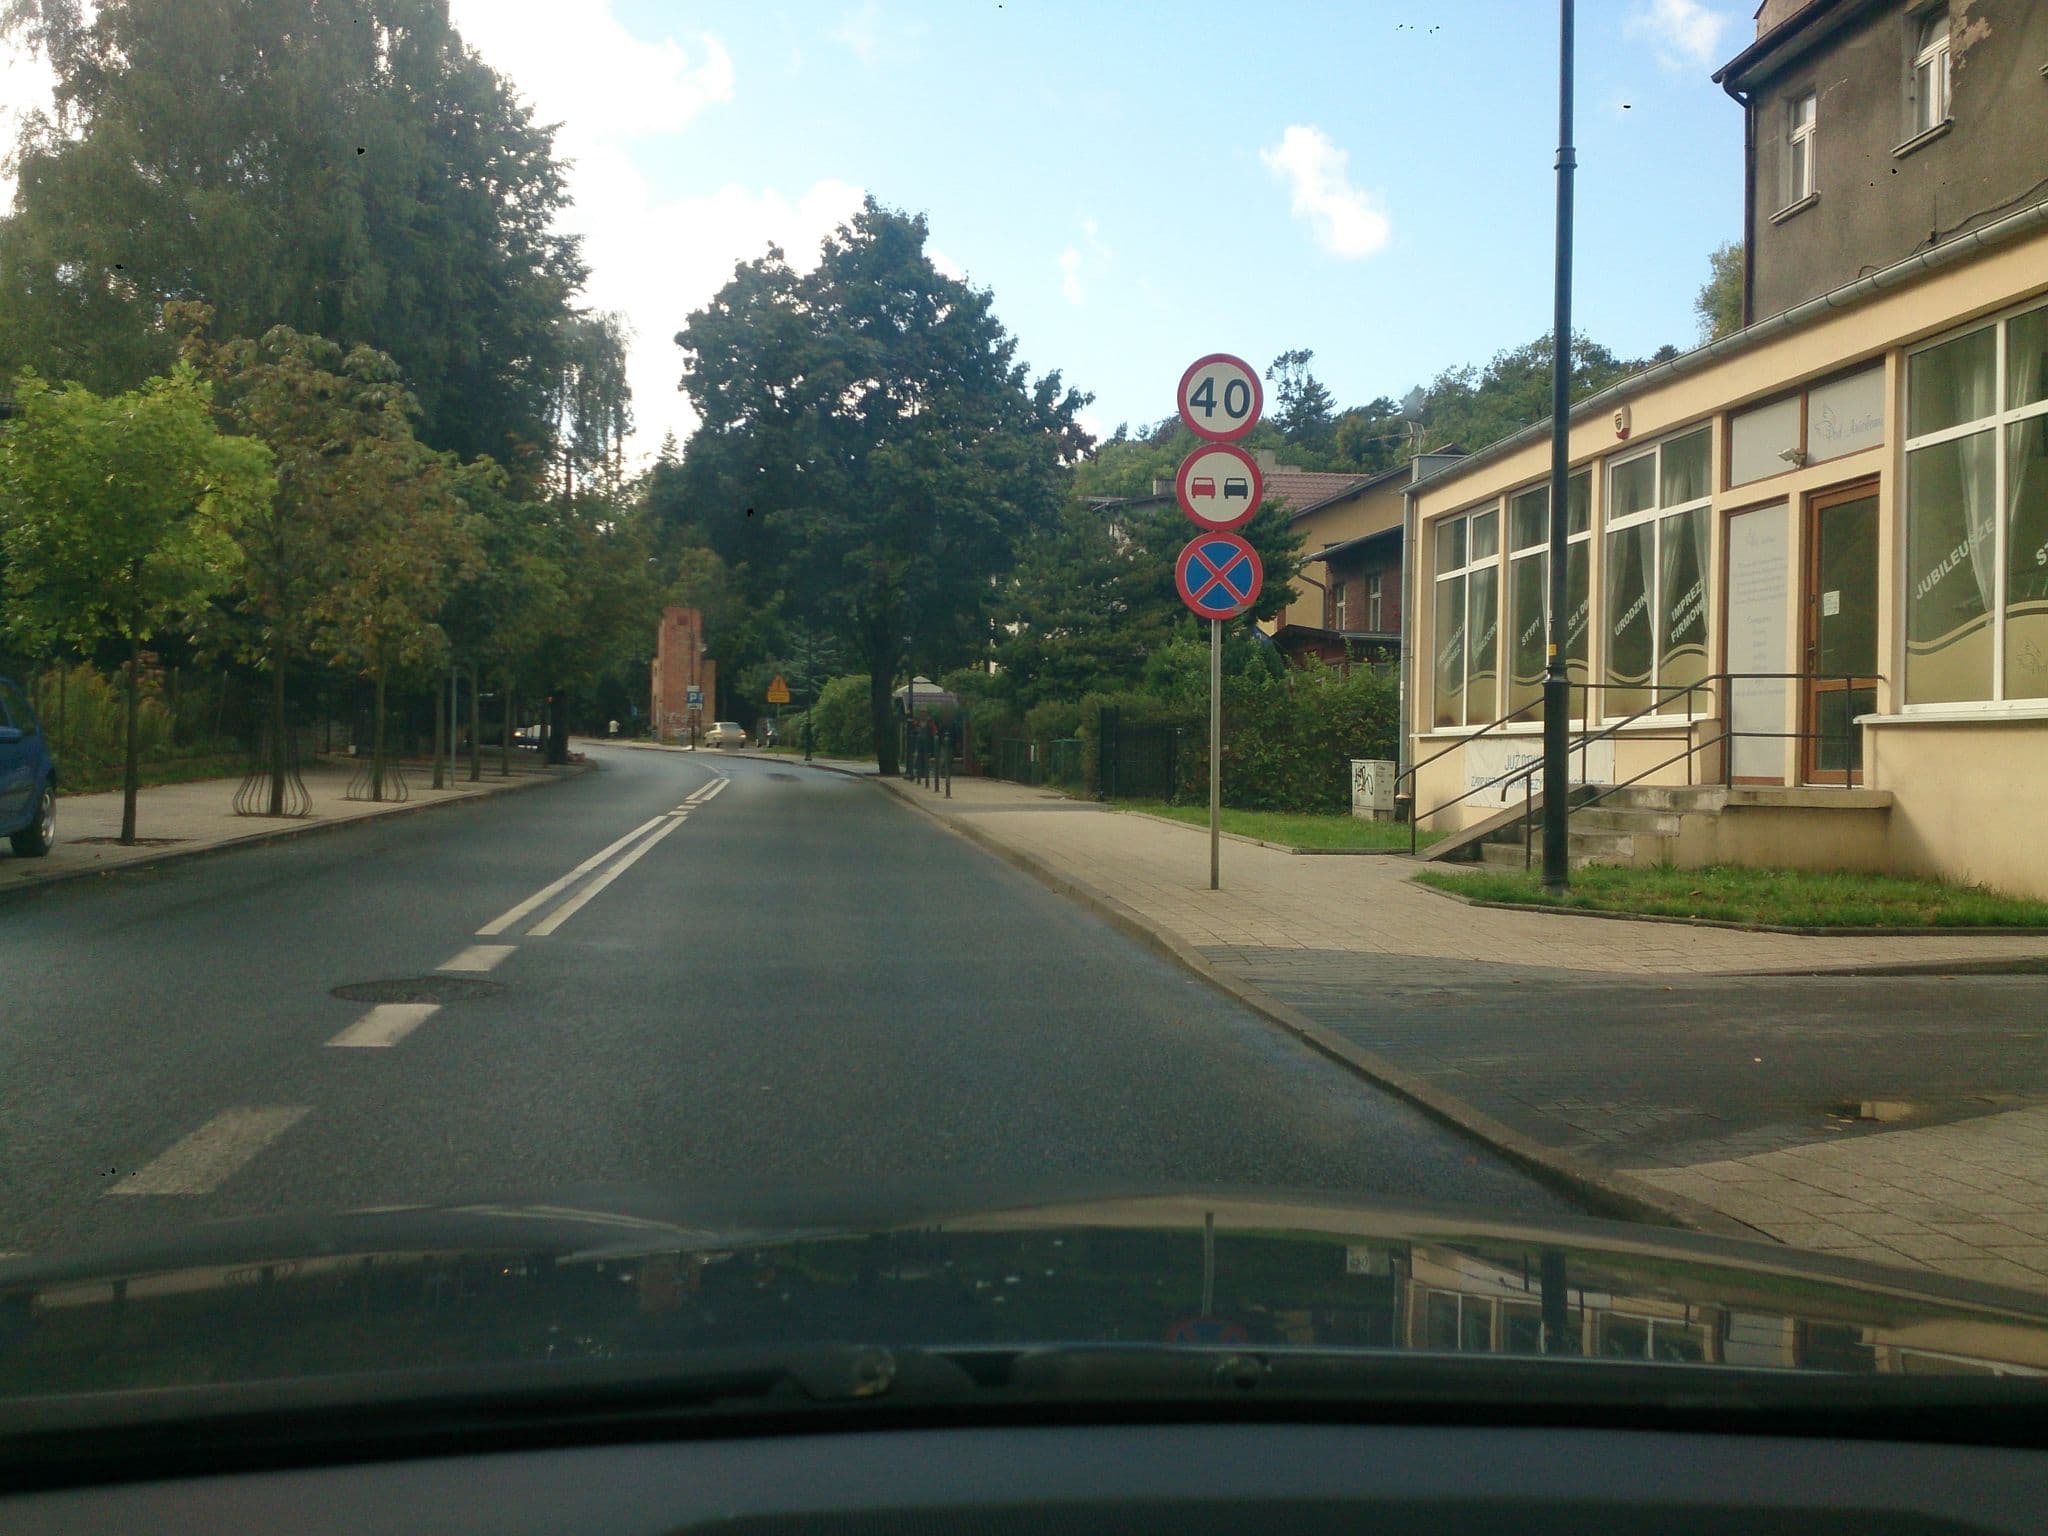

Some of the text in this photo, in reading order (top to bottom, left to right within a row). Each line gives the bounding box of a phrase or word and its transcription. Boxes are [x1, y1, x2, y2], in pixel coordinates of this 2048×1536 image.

[1189, 376, 1250, 419] 40
[1916, 517, 1995, 600] JUBILEUSZE
[689, 692, 697, 702] P
